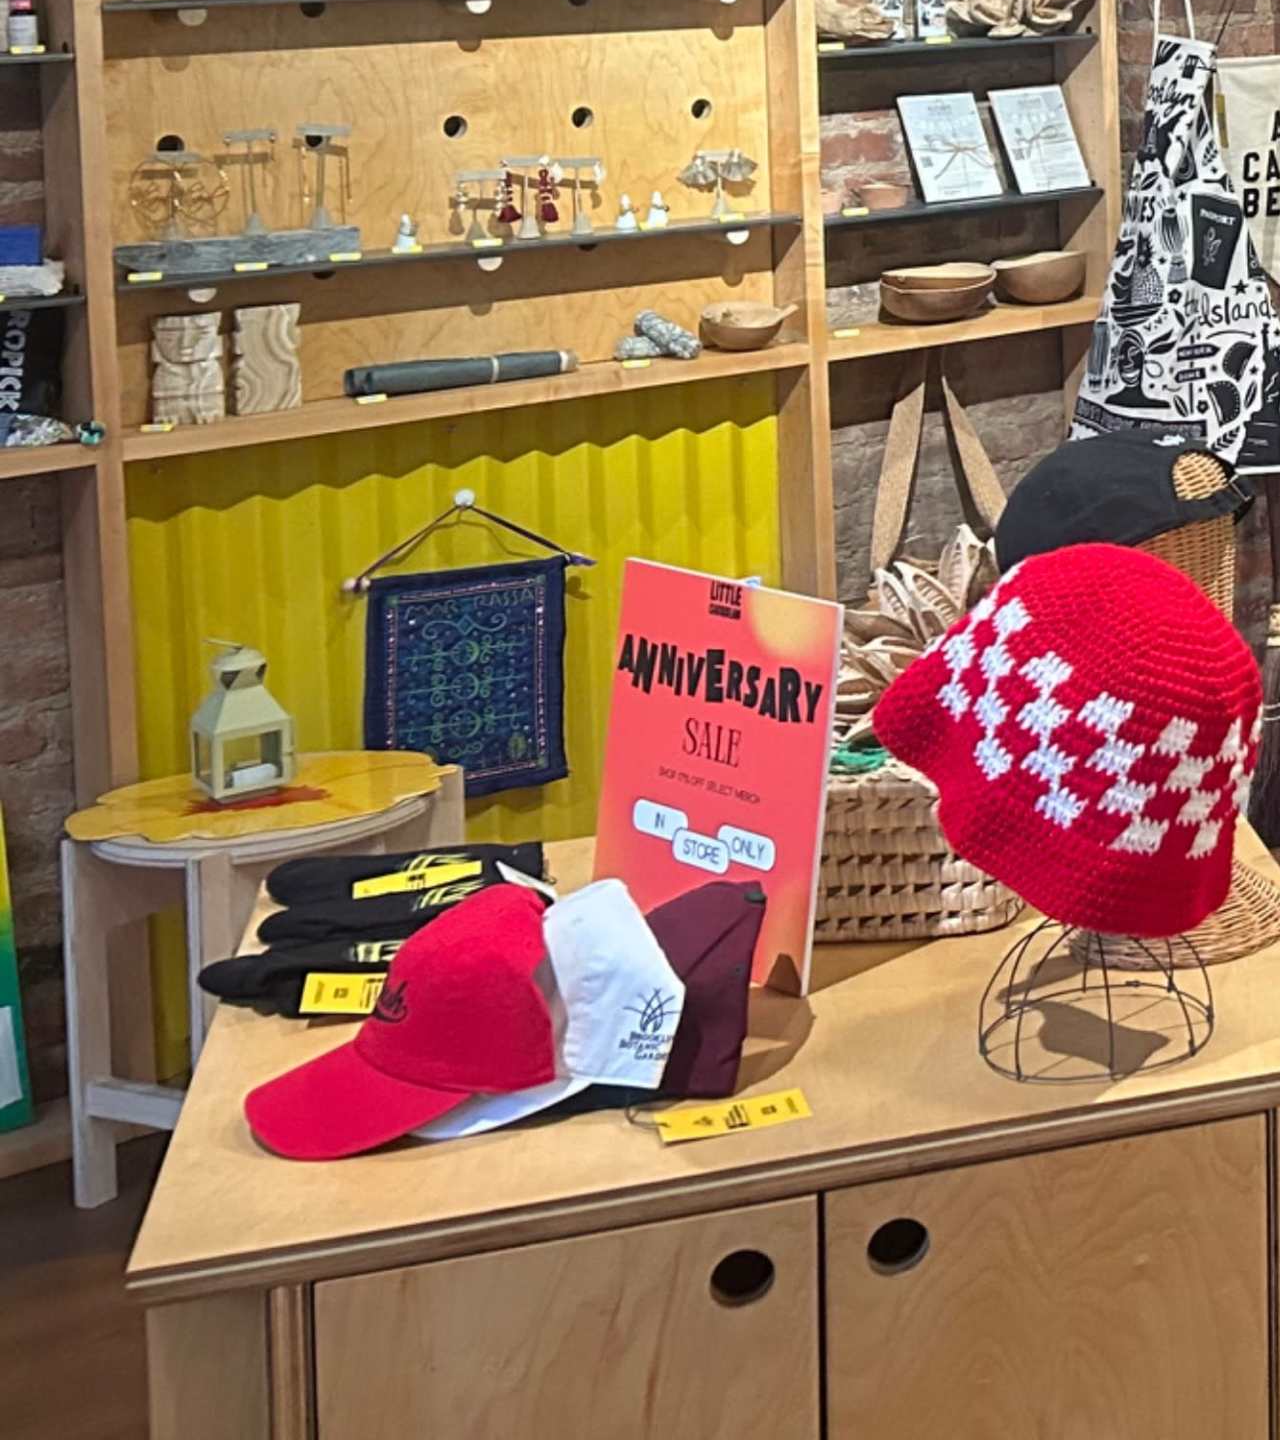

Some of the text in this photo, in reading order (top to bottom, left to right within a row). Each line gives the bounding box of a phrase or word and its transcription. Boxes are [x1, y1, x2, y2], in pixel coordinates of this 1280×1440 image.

[710, 580, 742, 606] LITTLE
[618, 634, 824, 724] ANNIVERSARY
[682, 716, 742, 769] SALE
[683, 838, 720, 865] STORE
[731, 836, 766, 860] ONLY
